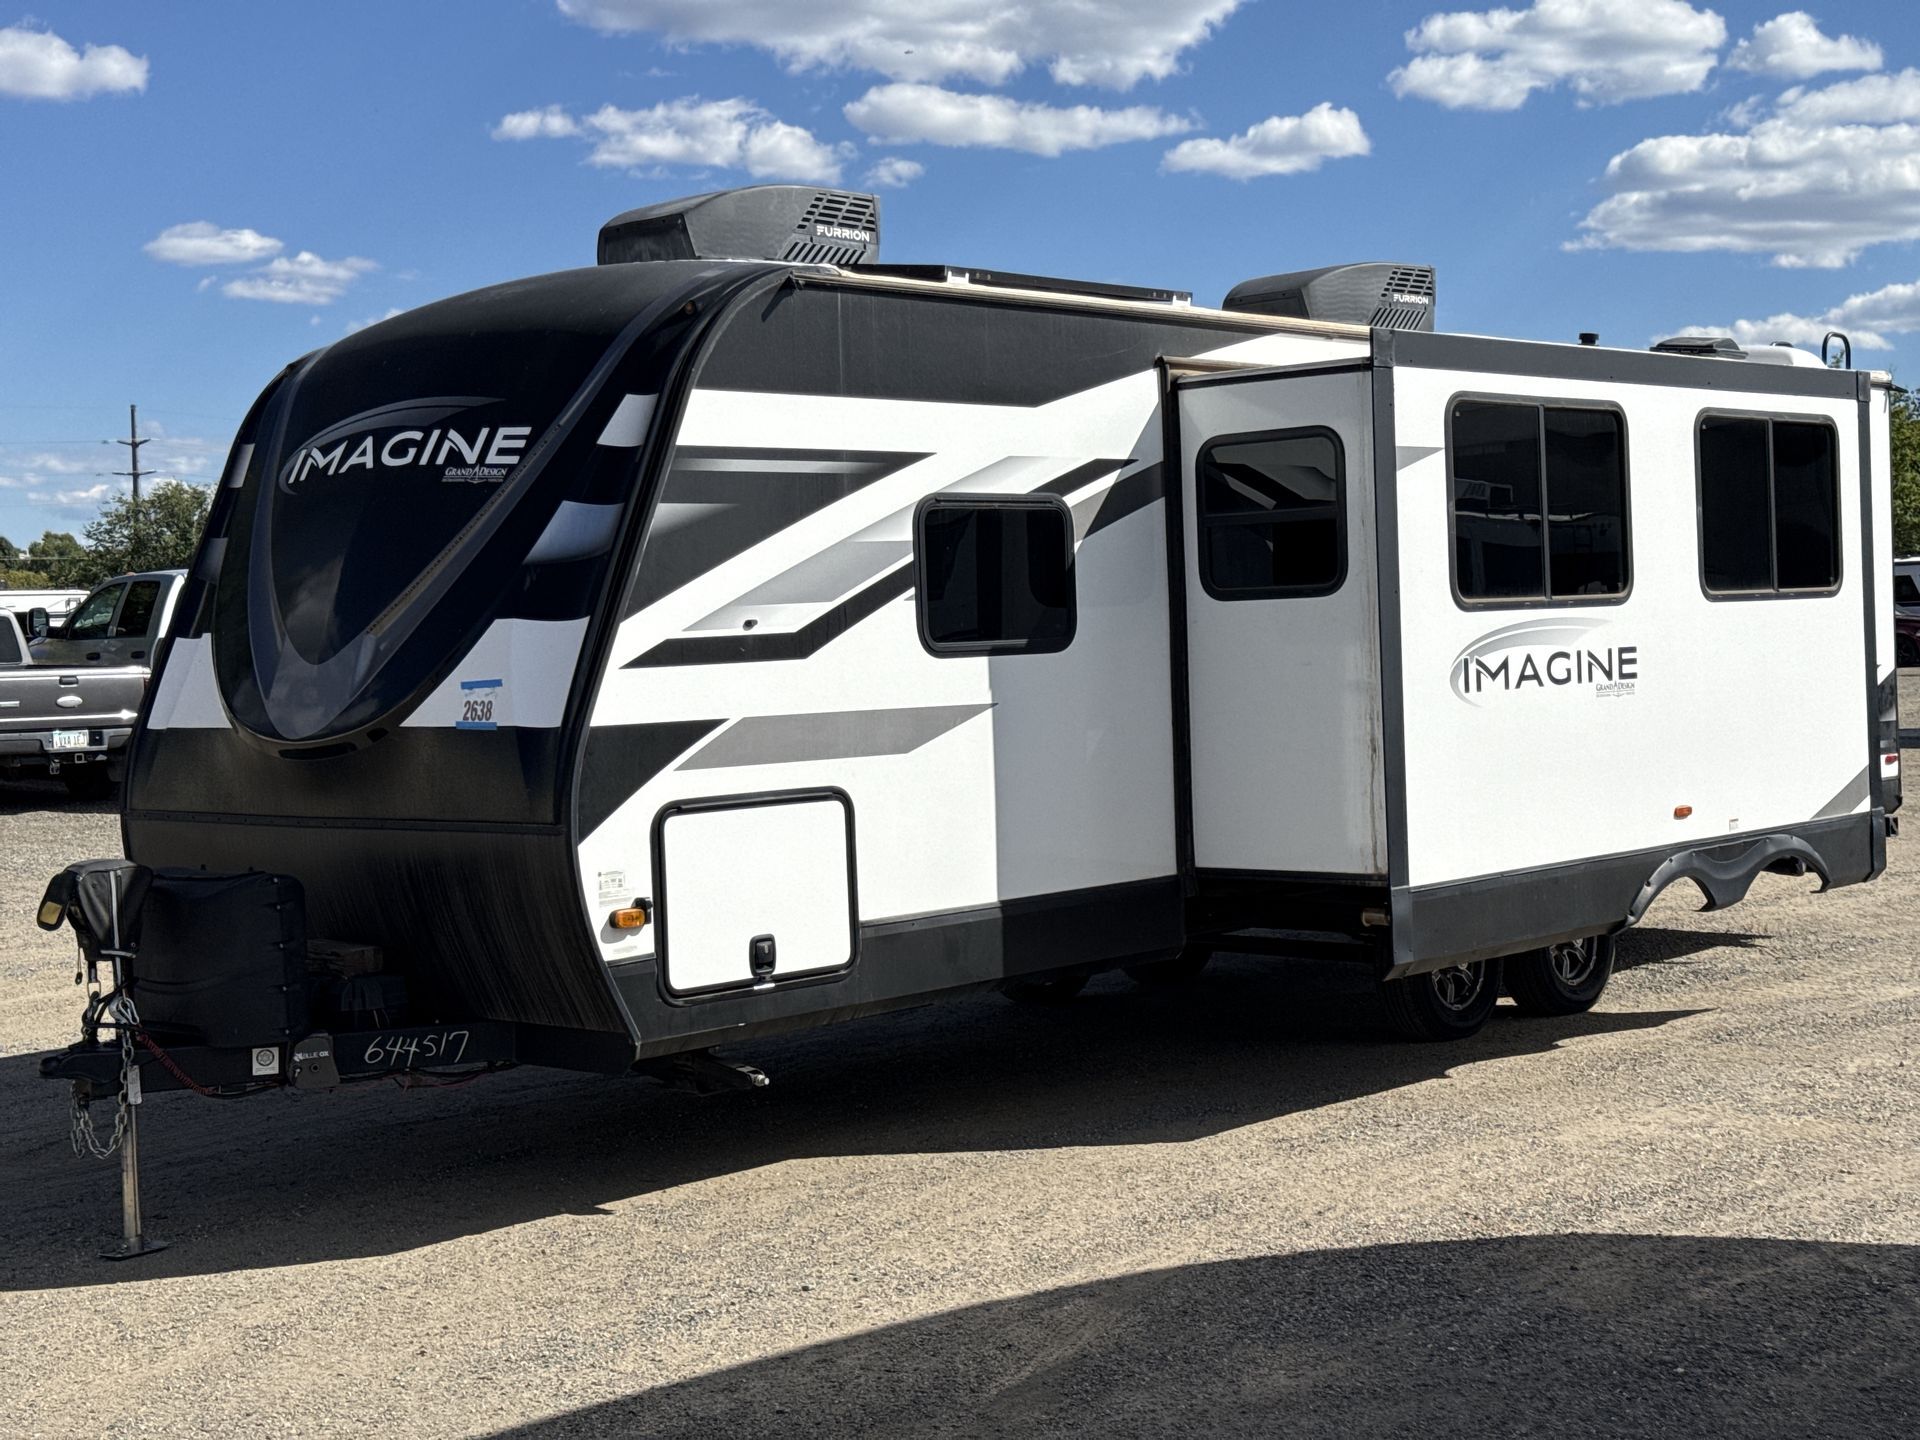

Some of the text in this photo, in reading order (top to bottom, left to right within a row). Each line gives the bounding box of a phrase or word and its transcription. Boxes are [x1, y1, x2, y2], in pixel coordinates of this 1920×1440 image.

[816, 225, 870, 242] FURRION
[1393, 293, 1429, 305] FURRION
[287, 426, 533, 485] IMAGINE
[445, 466, 508, 476] GRAND DESIGN
[1463, 646, 1638, 694] IMAGINE
[1596, 683, 1613, 691] GRAND
[462, 700, 494, 721] 2638
[364, 1030, 470, 1066] 644517
